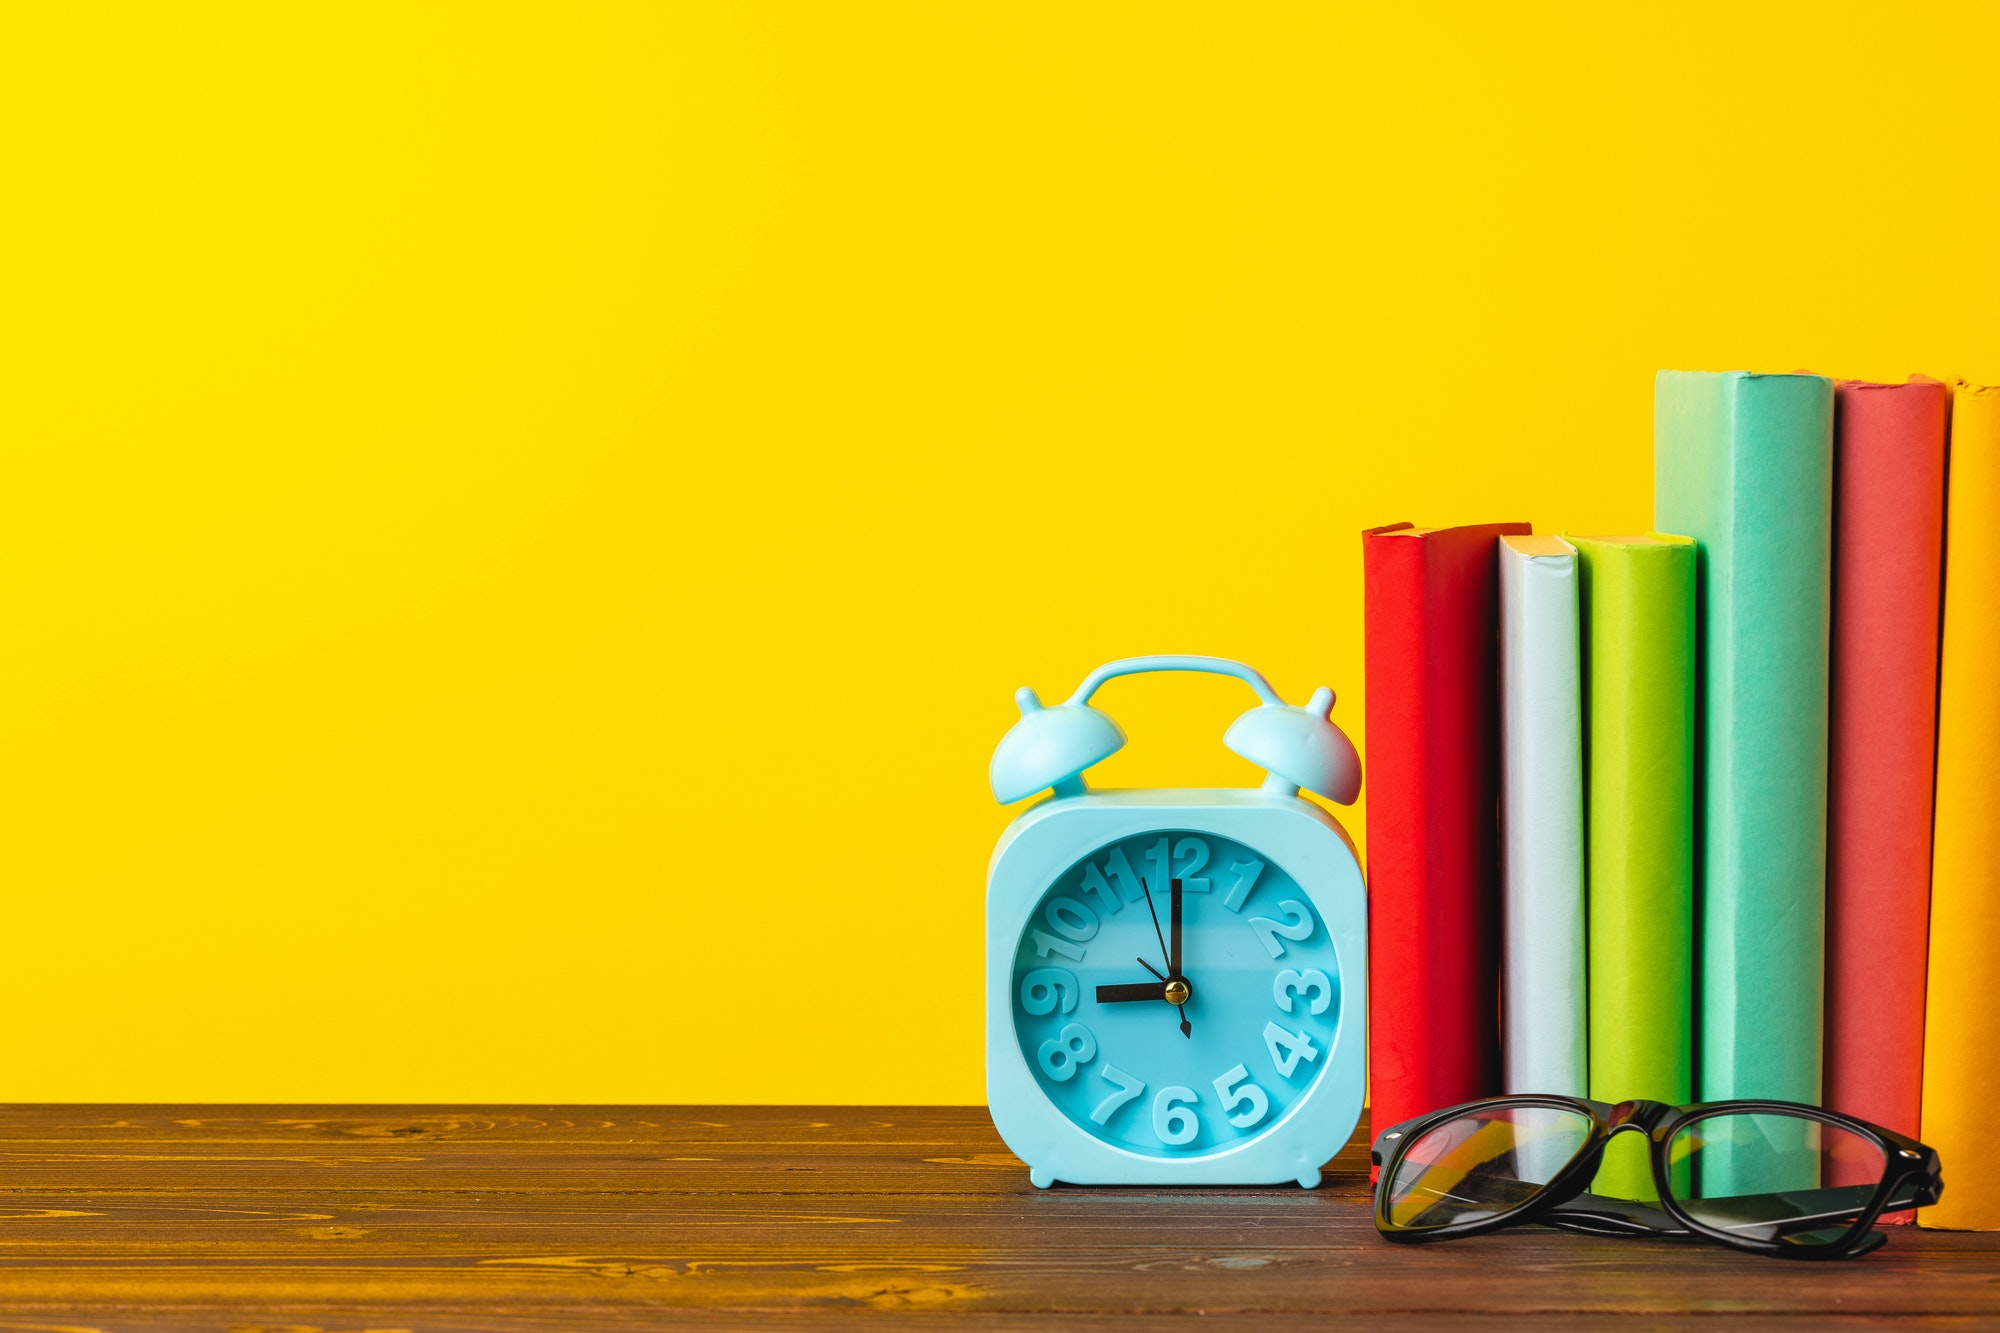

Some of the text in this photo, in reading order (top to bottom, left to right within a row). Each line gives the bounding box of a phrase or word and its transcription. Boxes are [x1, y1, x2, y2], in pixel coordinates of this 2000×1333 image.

[1080, 845, 1145, 914] 11
[1146, 837, 1210, 892] 12
[1224, 857, 1265, 913] 1
[1031, 897, 1099, 961] 10
[1248, 900, 1314, 959] 2
[1021, 967, 1079, 1015] 9
[1273, 969, 1331, 1015] 3
[1037, 1022, 1097, 1082] 8
[1263, 1021, 1318, 1078] 4
[1090, 1063, 1146, 1126] 7
[1153, 1086, 1199, 1145] 6
[1213, 1063, 1269, 1128] 5
